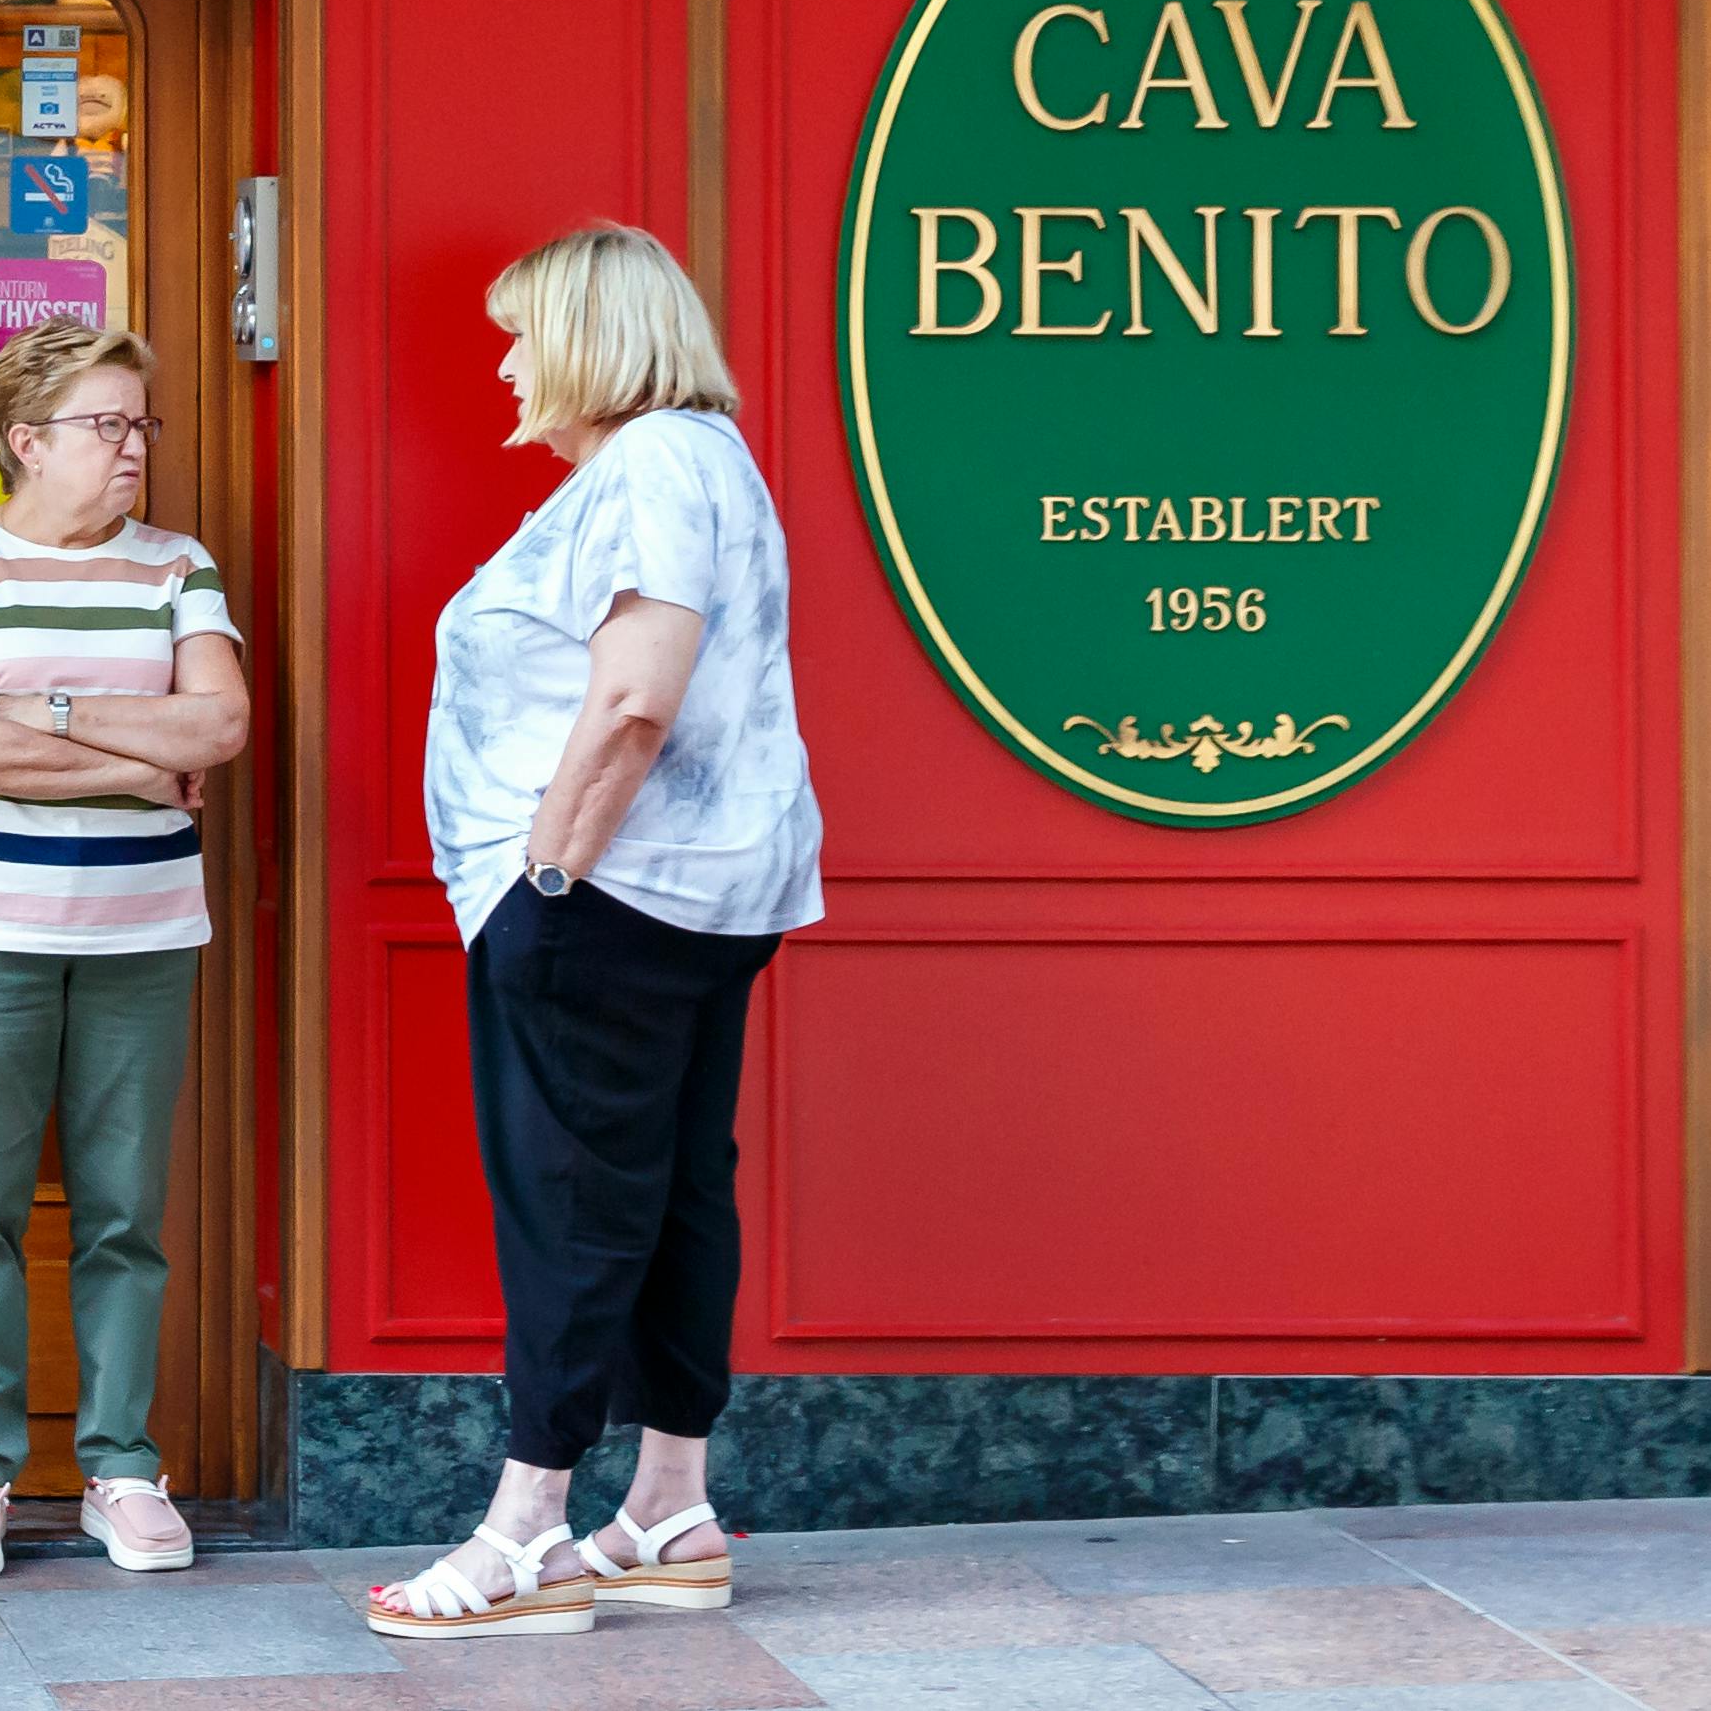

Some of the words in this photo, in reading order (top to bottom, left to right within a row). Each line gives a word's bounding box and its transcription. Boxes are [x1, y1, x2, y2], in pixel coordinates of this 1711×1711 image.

[1012, 0, 1418, 131] CAVA
[908, 206, 1511, 338] BENITO
[1038, 495, 1382, 543] ESTABLERT
[1144, 585, 1268, 633] 1956
